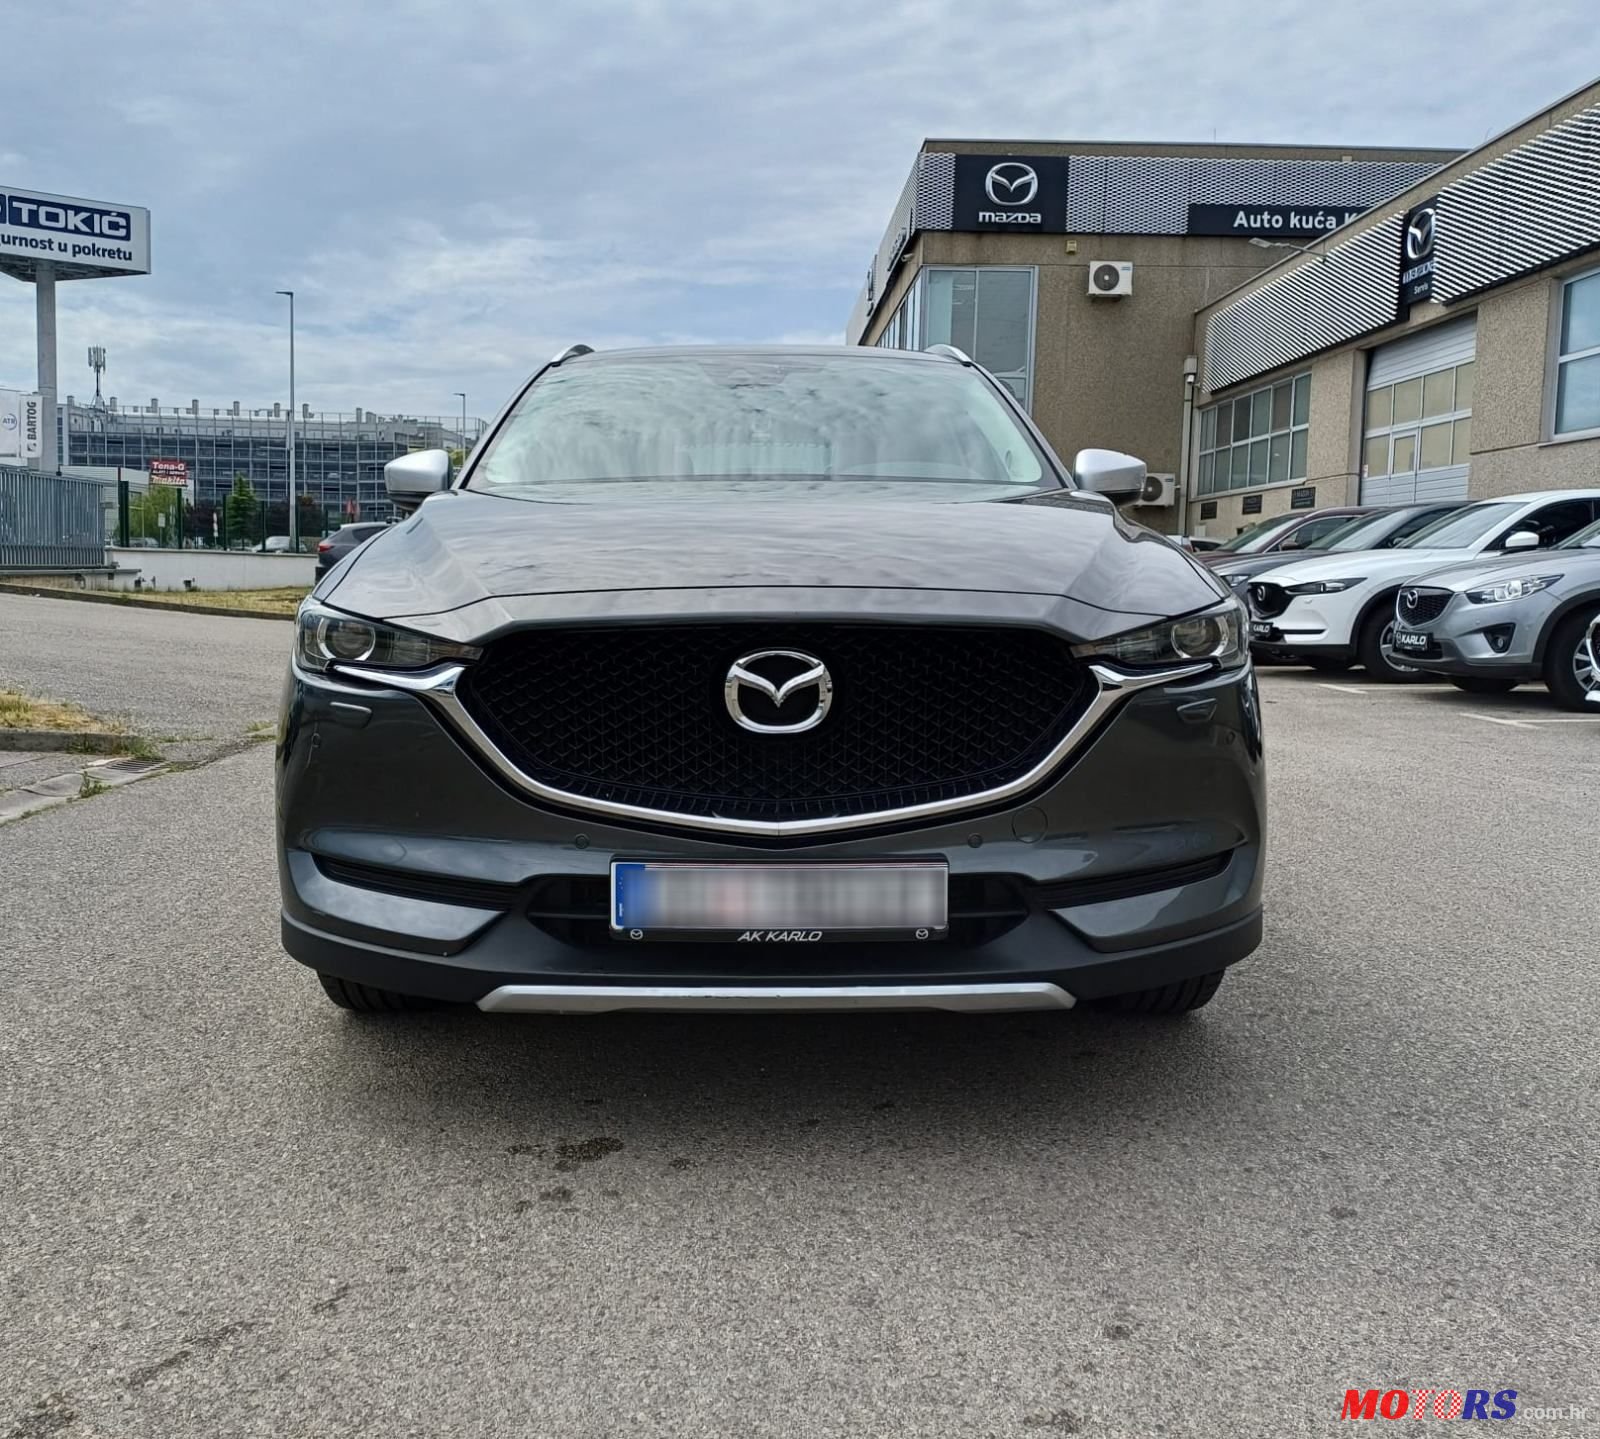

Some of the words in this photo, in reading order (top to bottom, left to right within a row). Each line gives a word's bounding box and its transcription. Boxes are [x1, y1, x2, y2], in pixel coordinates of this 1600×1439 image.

[12, 201, 127, 237] TOKIĆ
[1233, 210, 1283, 228] Auto
[1289, 211, 1337, 229] kuća
[0, 233, 55, 252] urnost
[58, 242, 68, 253] u
[72, 243, 132, 261] pokretu
[26, 401, 37, 441] BARTOG
[1401, 634, 1427, 646] KARLO
[737, 931, 761, 942] AK
[764, 931, 823, 942] KARLO
